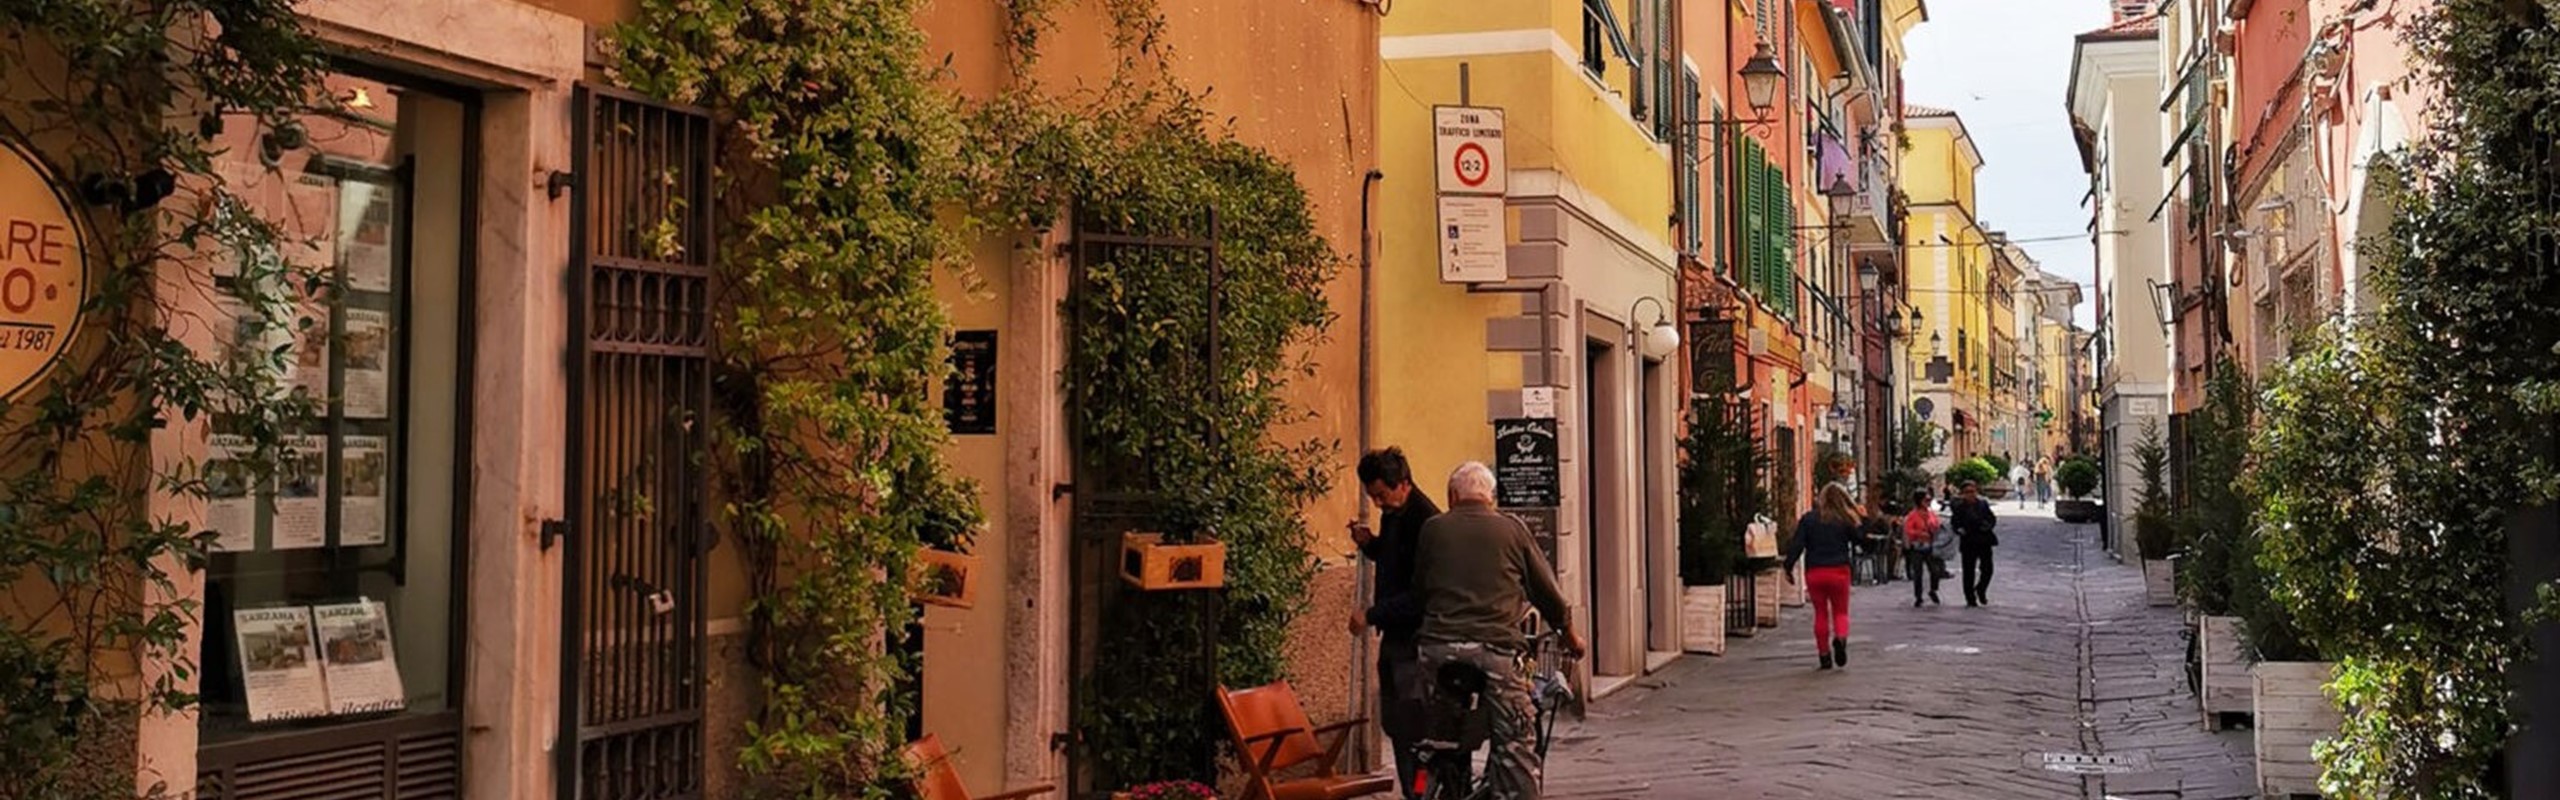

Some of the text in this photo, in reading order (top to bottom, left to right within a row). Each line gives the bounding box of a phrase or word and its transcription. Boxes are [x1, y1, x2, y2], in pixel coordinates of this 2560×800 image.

[1460, 114, 1479, 124] ZONA
[1439, 126, 1501, 138] TRAFFICO LIMITATO
[0, 219, 64, 266] RE
[15, 328, 55, 352] 1987
[319, 606, 366, 621] SARZAN
